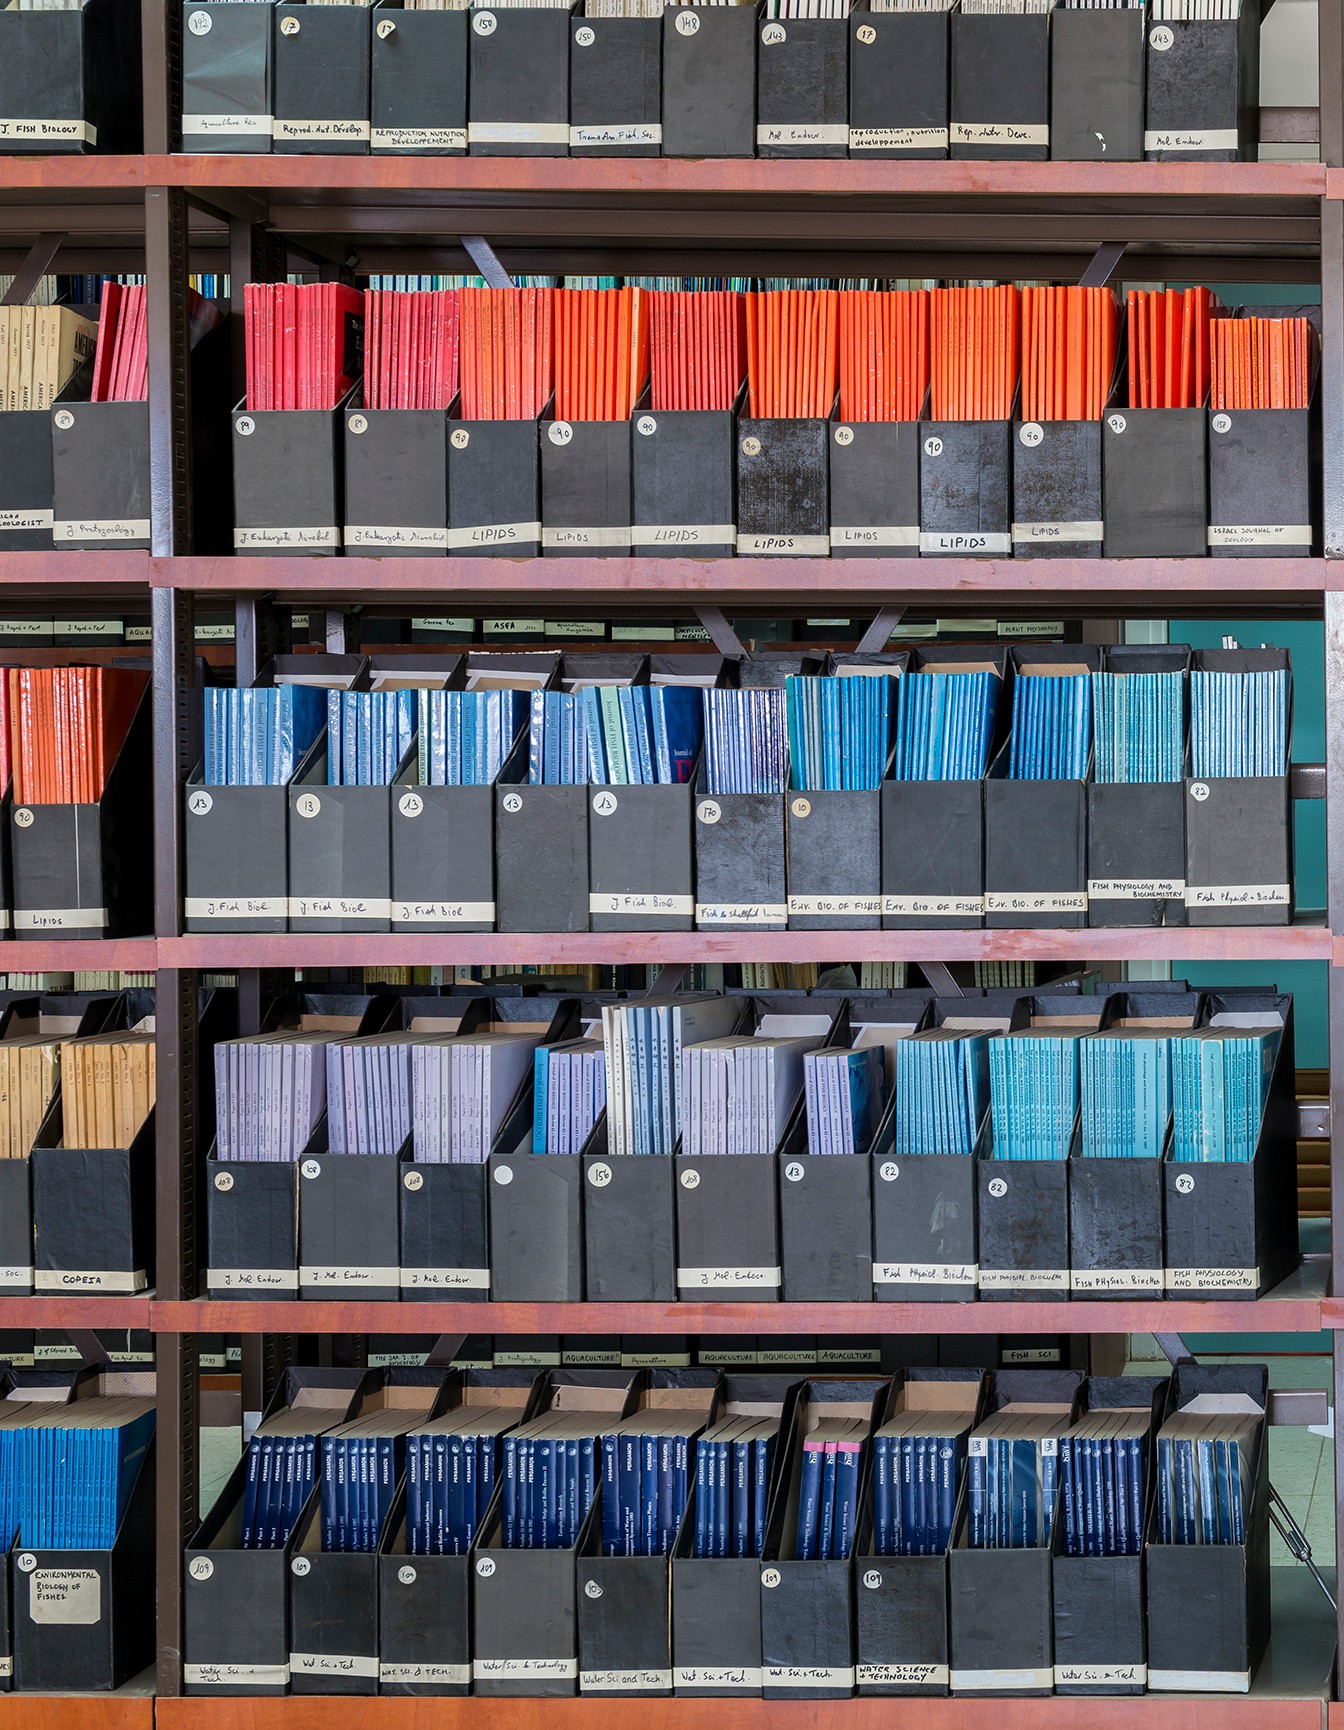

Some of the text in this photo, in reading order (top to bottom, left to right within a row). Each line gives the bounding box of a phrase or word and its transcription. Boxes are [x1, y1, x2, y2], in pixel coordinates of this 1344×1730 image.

[682, 16, 697, 30] 148
[766, 31, 783, 41] 143
[862, 30, 873, 39] 17
[1152, 34, 1169, 43] 143
[41, 123, 77, 133] BIOLOGY
[430, 131, 466, 139] NUTRITION
[643, 423, 653, 431] 90
[557, 427, 569, 439] 90
[839, 431, 849, 440] 90
[1026, 432, 1038, 441] 90
[928, 441, 941, 455] 90
[472, 528, 516, 541] LIPIDS
[654, 530, 699, 542] LIPIDS
[845, 530, 878, 540] LIPIDS
[1031, 526, 1059, 536] LIPIDS
[556, 532, 588, 542] LIPIDS
[754, 538, 794, 549] LIPIDS
[940, 537, 986, 549] LIPIDS
[193, 798, 207, 809] 13
[404, 798, 419, 810] 13
[506, 798, 519, 809] 13
[598, 799, 612, 809] 13
[19, 812, 30, 822] 90
[704, 807, 716, 818] 170
[1113, 883, 1154, 892] PHYSIOLOGY
[855, 902, 882, 910] FISHES
[1012, 899, 1032, 908] BIO.
[1052, 898, 1084, 907] FISHES
[596, 1169, 609, 1181] 156
[788, 1167, 800, 1177] 13
[885, 1166, 897, 1176] 82
[991, 1183, 1002, 1192] 82
[1179, 1179, 1191, 1190] 82
[62, 1275, 101, 1284] COPEIA
[1198, 1278, 1252, 1287] BIOCHEMISTRY
[704, 1353, 753, 1361] AQUACULTURE
[821, 1351, 873, 1360] AQUACULTURE
[22, 1556, 33, 1566] 10
[193, 1563, 209, 1575] 109
[480, 1564, 492, 1573] 109
[35, 1571, 97, 1579] ENVIRONMENTAL
[866, 1574, 881, 1583] 109
[37, 1582, 68, 1593] BIOLOGY
[622, 1674, 638, 1683] and
[641, 1672, 663, 1683] Tech.
[868, 1673, 927, 1682] TECHNOLOGY
